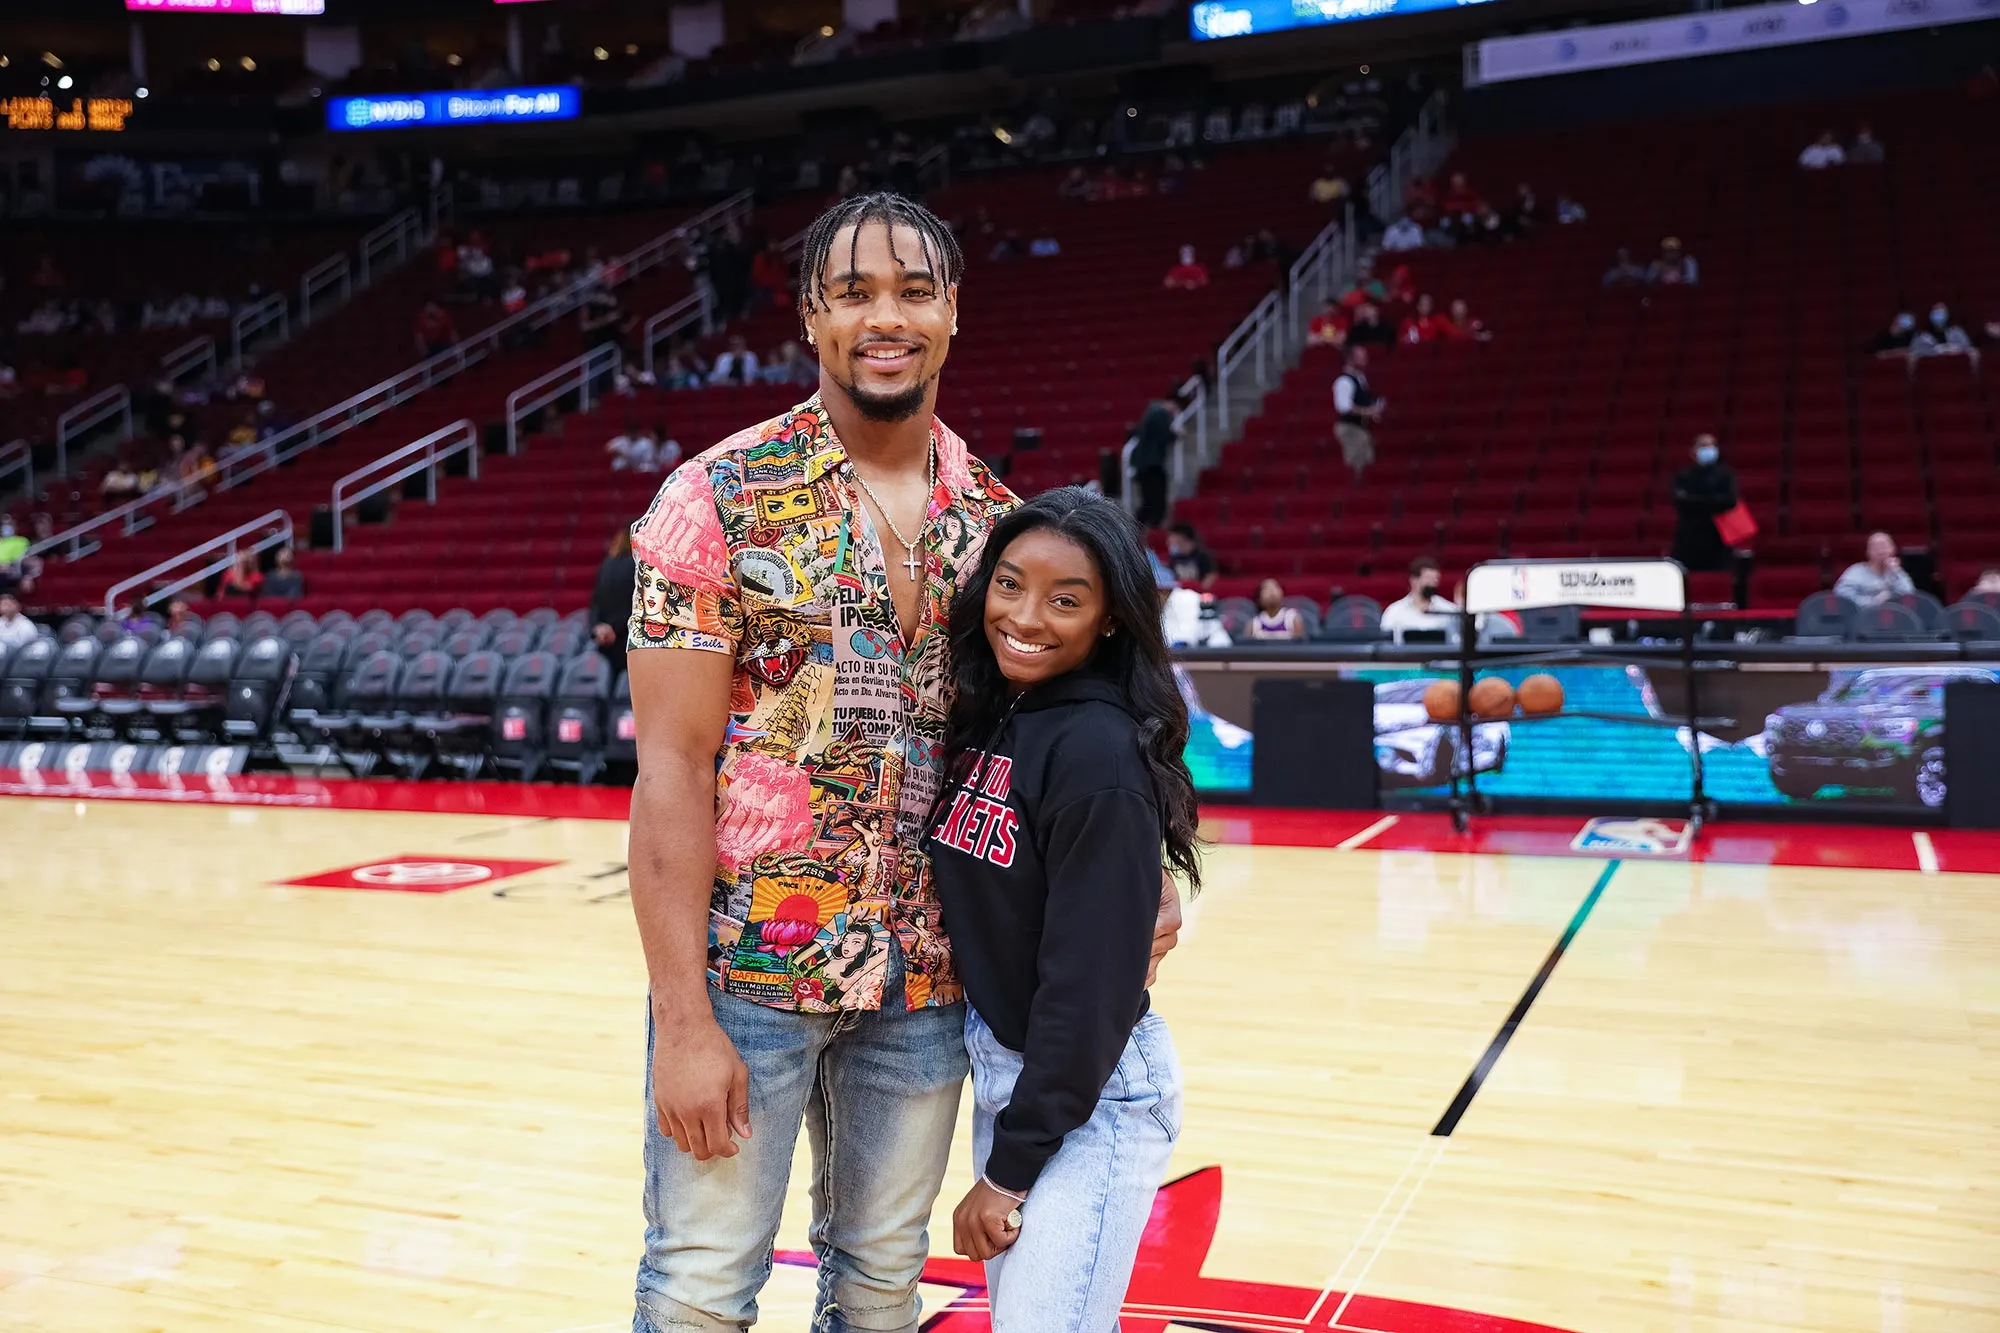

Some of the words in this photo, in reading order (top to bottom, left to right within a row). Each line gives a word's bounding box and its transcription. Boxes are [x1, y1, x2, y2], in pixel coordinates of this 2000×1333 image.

[692, 636, 724, 649] Sails
[835, 660, 861, 674] ACTO
[864, 661, 875, 674] EN
[877, 662, 888, 676] SU
[851, 676, 860, 684] en
[850, 687, 860, 696] en
[833, 707, 848, 720] TU
[848, 707, 886, 721] PUEBLO
[778, 881, 799, 890] PRICE
[730, 970, 772, 982] SAFETY
[749, 983, 776, 991] MATCH
